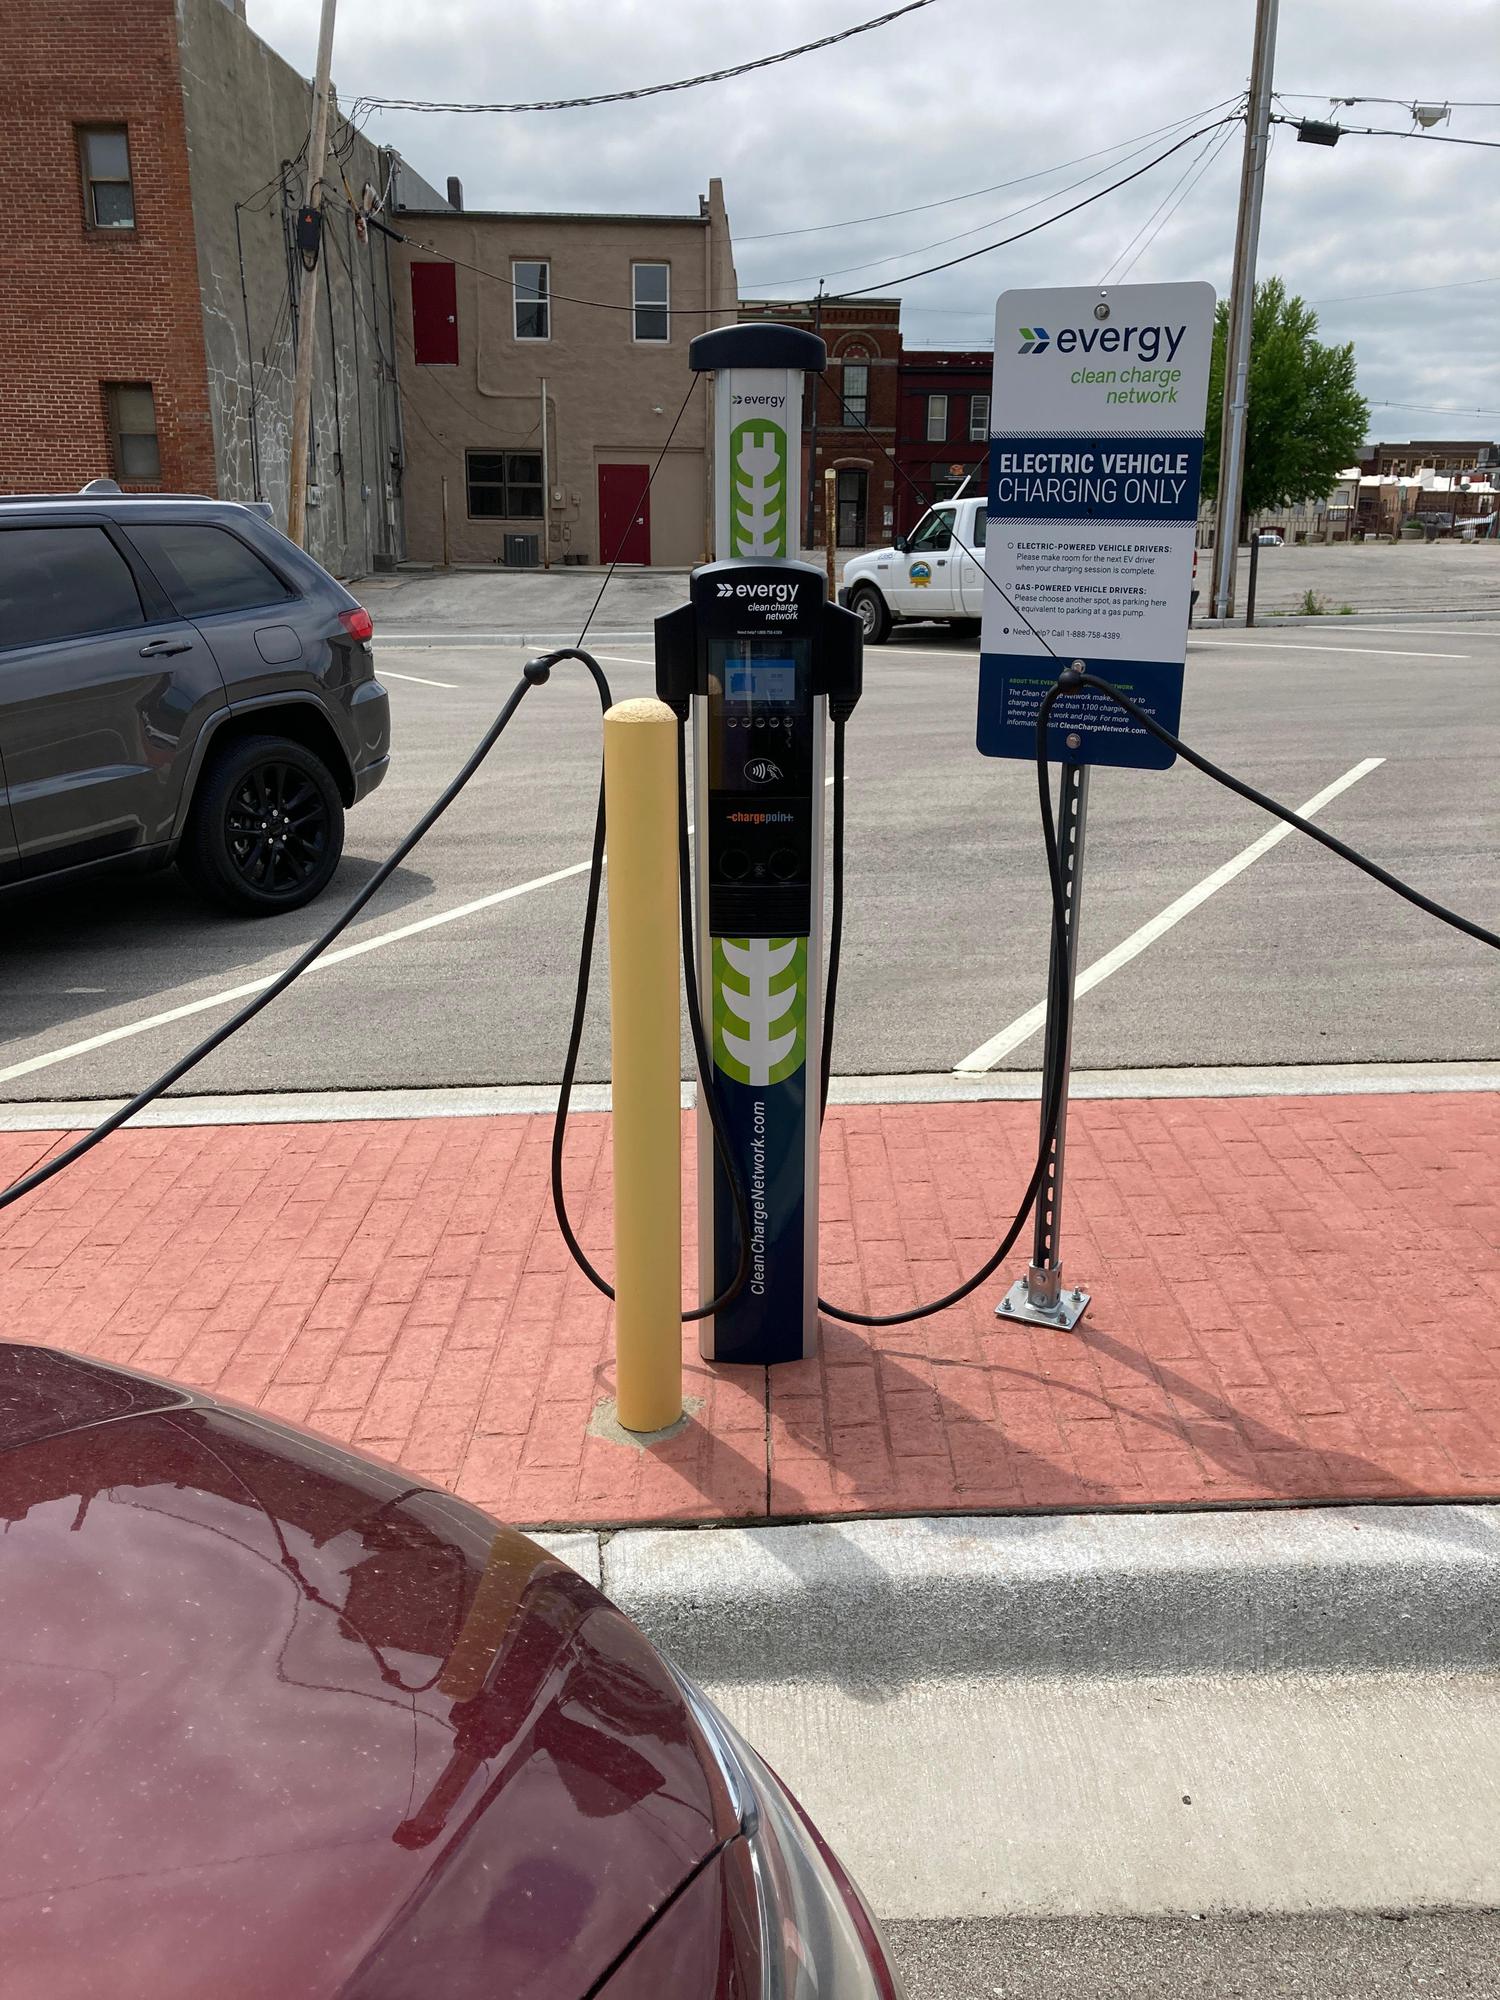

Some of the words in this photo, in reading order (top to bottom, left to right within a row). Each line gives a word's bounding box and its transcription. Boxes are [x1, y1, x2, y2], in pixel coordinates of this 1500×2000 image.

[1056, 325, 1188, 363] evergy
[1070, 367, 1117, 384] clean
[1119, 366, 1182, 388] charge
[744, 395, 785, 408] evergy
[1106, 387, 1178, 404] network
[999, 453, 1095, 474] ELECTRIC
[1101, 453, 1189, 475] VEHICLE
[998, 477, 1118, 504] CHARGING
[1124, 478, 1187, 505] ONLY
[1017, 542, 1096, 551] ELECTRIC-POWERED
[1098, 544, 1132, 552] VEHICLE
[1134, 545, 1173, 553] DRIVERS:
[1016, 552, 1040, 561] Please
[1082, 554, 1092, 562] for
[1093, 555, 1105, 563] the
[1123, 555, 1134, 563] EV
[1135, 556, 1156, 564] driver
[1036, 565, 1051, 573] your
[1052, 565, 1083, 574] charging
[1084, 566, 1112, 574] session
[1113, 566, 1119, 574] is
[736, 584, 799, 602] evergy
[1015, 583, 1072, 592] GAS-POWERED
[1074, 585, 1108, 593] VEHICLE
[1109, 586, 1147, 595] DRIVERS:
[1014, 594, 1038, 602] Please
[1038, 595, 1064, 603] choose
[1065, 596, 1092, 604] another
[1122, 598, 1150, 607] parking
[1151, 599, 1167, 607] here
[747, 602, 770, 612] clean
[770, 602, 799, 613] charge
[1021, 605, 1056, 613] equivalent
[1057, 606, 1065, 614] to
[1066, 607, 1092, 616] parking
[765, 612, 799, 621] network
[1012, 628, 1031, 636] Need
[1051, 629, 1065, 637] Call
[1009, 688, 1020, 696] The
[1021, 689, 1040, 697] Clean
[1007, 699, 1030, 708] charge
[1065, 702, 1080, 710] than
[1081, 703, 1099, 711] 1,100
[1099, 714, 1111, 722] For
[750, 1101, 769, 1296] CleanChargeNetwork.com
